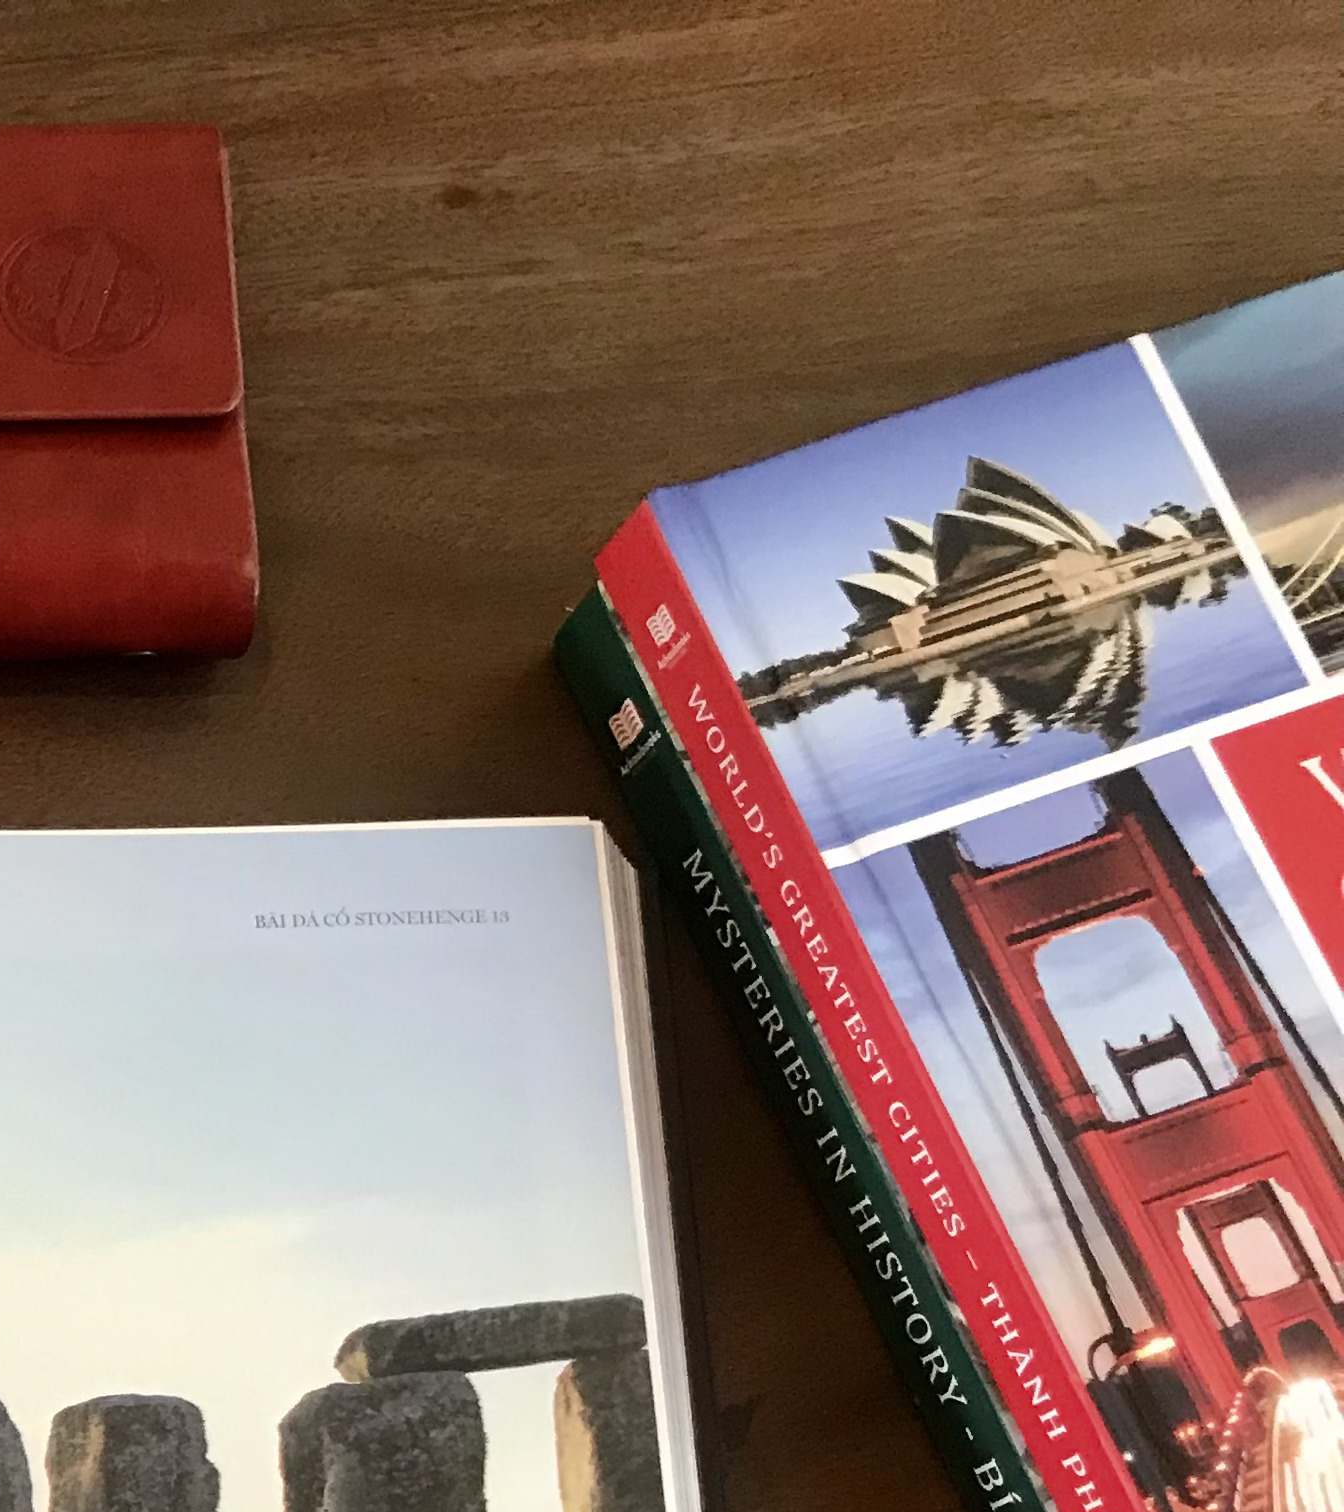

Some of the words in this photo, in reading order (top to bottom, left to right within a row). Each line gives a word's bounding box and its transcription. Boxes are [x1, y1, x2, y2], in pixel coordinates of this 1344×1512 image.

[354, 909, 487, 927] STONEHENGE
[682, 849, 824, 1116] MYSTERIES
[815, 1125, 857, 1182] IN
[847, 1194, 968, 1405] HISTORY
[973, 1458, 1022, 1512] BÍ
[688, 683, 784, 869] WORLD'S
[780, 879, 892, 1086] GREATEST
[888, 1100, 966, 1238] CITIES
[980, 1281, 1067, 1441] THÀNH
